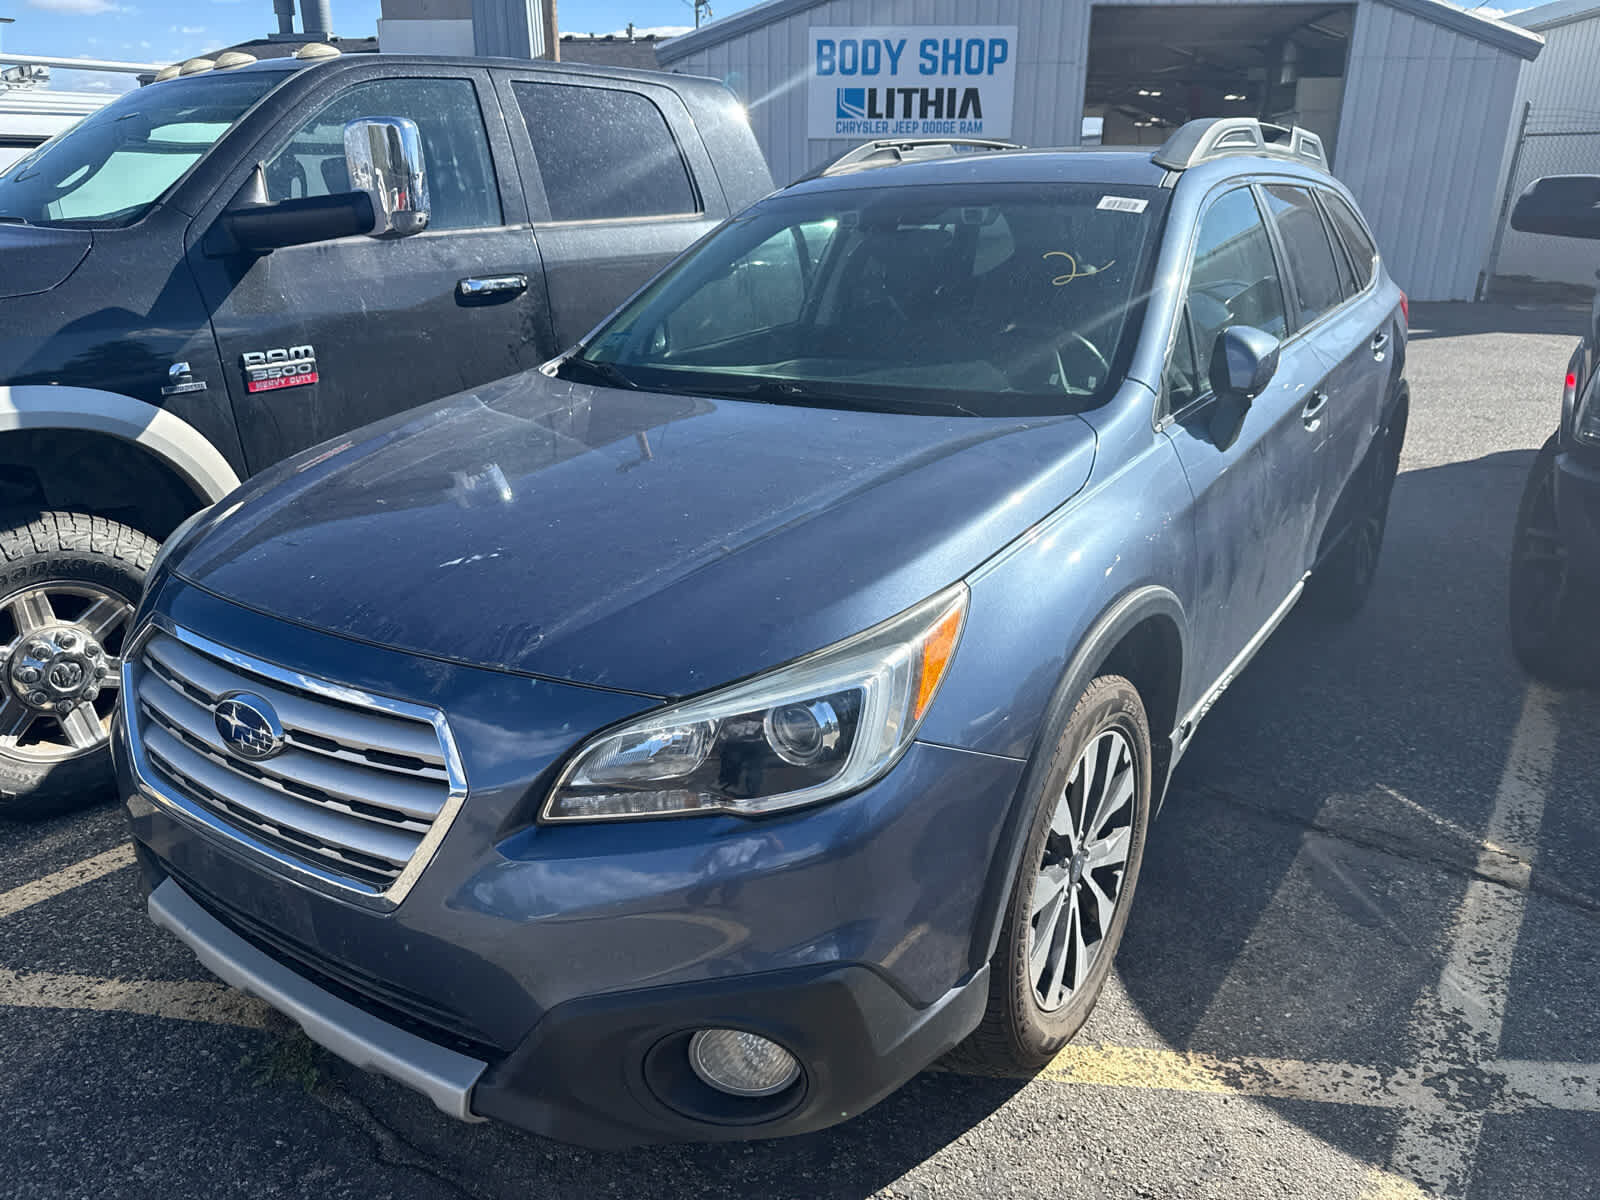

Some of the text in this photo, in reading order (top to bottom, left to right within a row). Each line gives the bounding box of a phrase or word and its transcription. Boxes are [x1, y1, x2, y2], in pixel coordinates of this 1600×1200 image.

[816, 38, 1009, 76] BODY SHOP
[867, 87, 983, 119] LITHIA
[835, 121, 983, 134] CHRYSLER JEEP DODGE RAM
[242, 345, 315, 366] RAM
[251, 363, 312, 381] 3500
[255, 374, 313, 389] HEAVY DUTY
